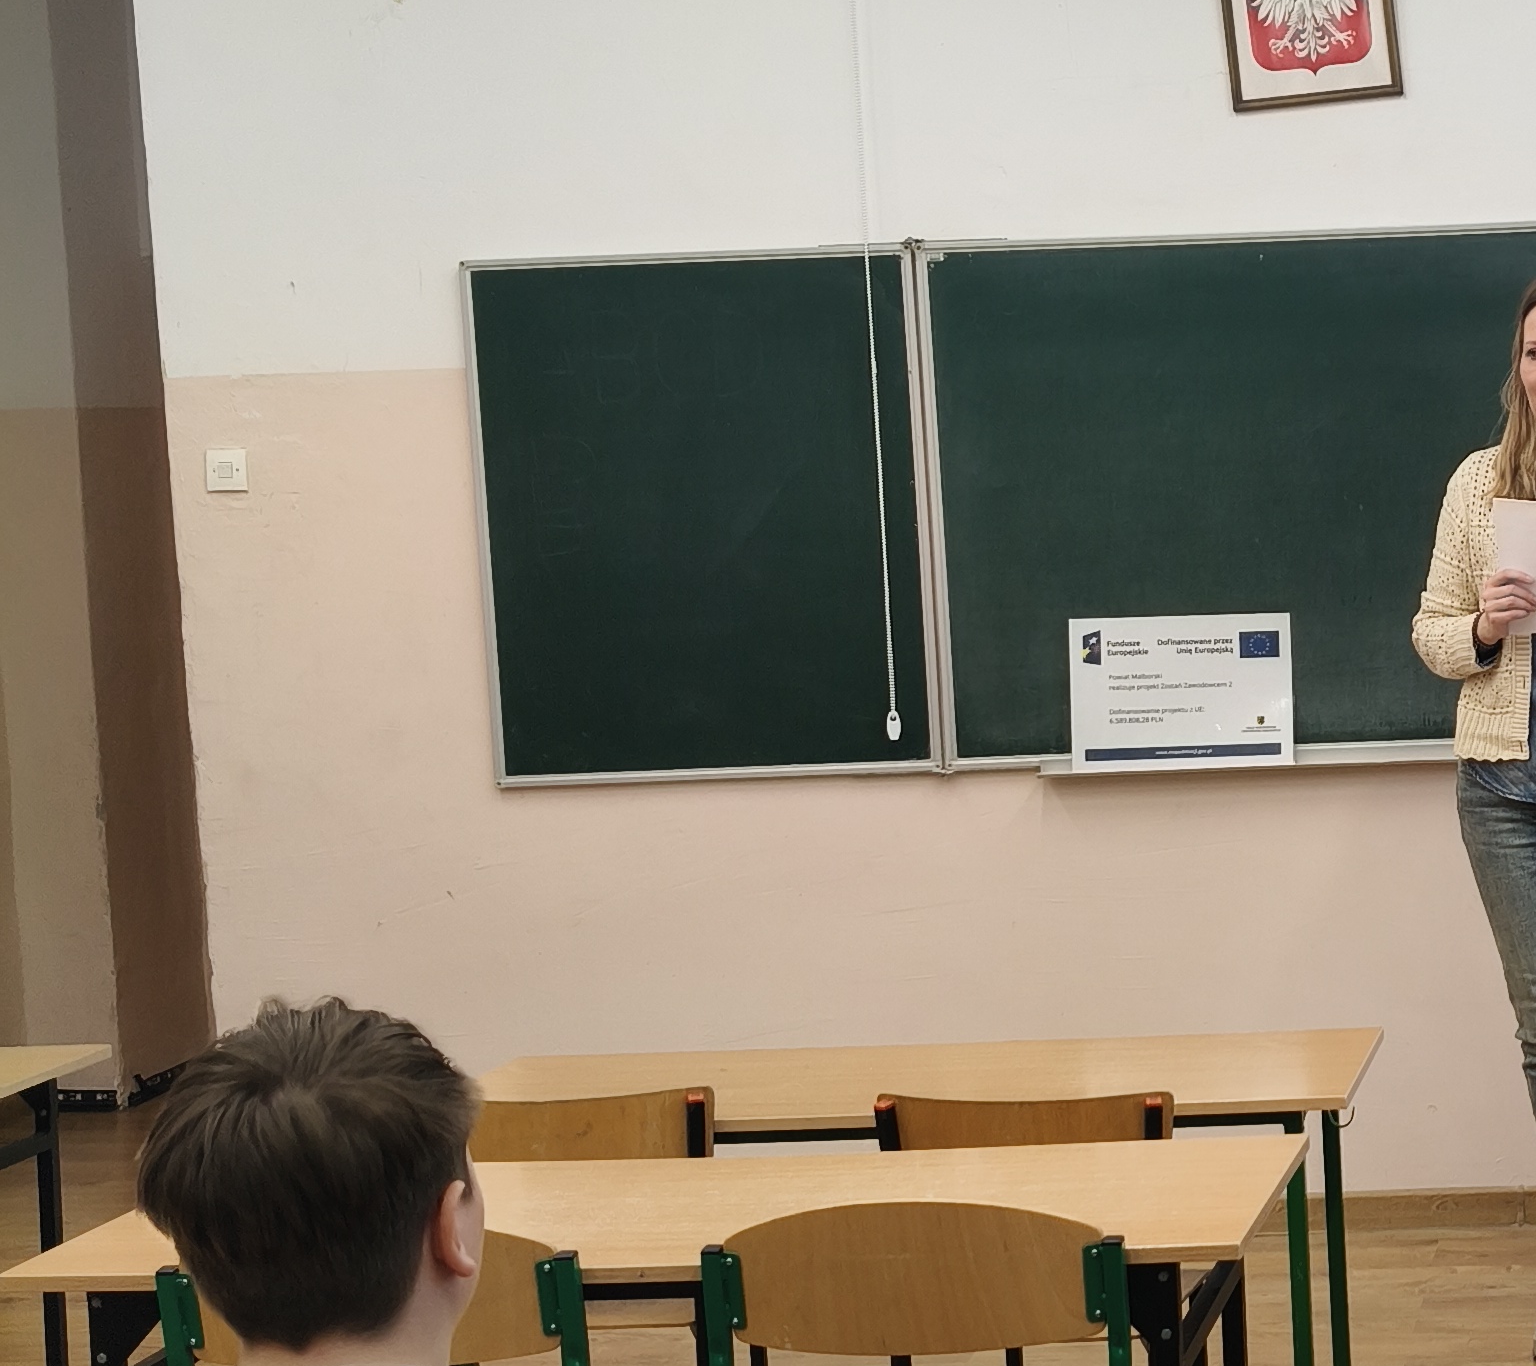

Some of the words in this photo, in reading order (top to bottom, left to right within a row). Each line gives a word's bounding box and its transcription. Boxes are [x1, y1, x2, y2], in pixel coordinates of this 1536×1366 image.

[1106, 639, 1141, 648] Fundusze
[1156, 638, 1212, 646] Dofinansowane
[1213, 638, 1233, 646] przez
[1107, 648, 1149, 657] Europejskie
[1176, 647, 1193, 655] Unię
[1194, 646, 1234, 654] Europejską
